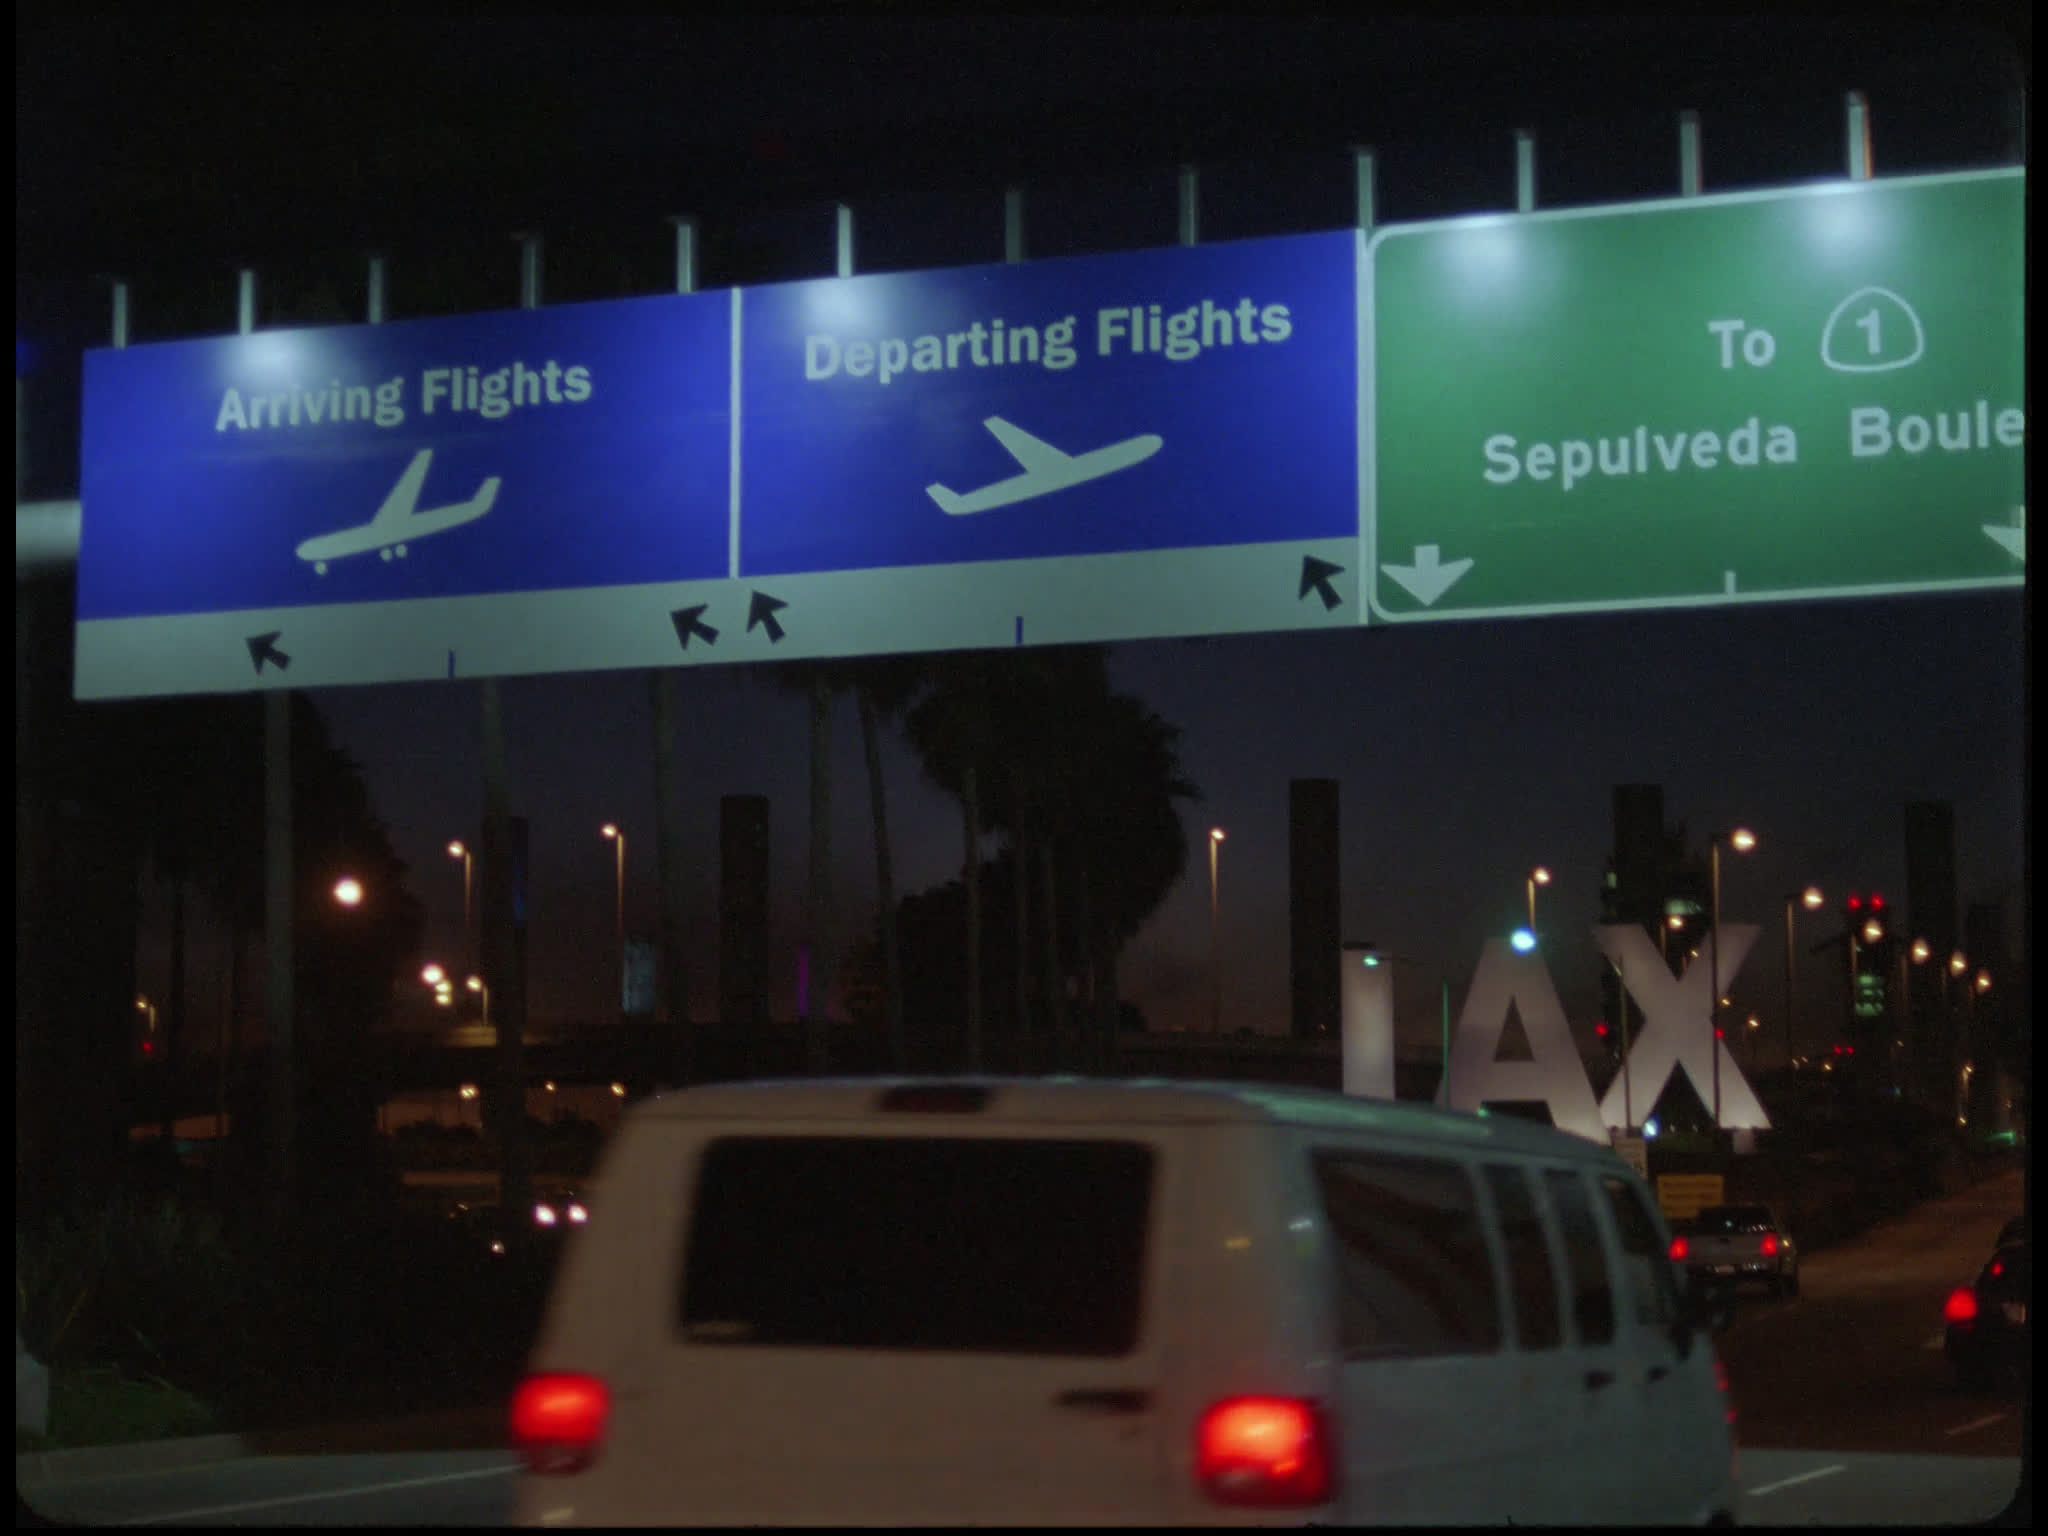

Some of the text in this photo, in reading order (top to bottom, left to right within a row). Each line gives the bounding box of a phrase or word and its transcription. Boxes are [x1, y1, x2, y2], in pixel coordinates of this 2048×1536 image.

[805, 298, 1292, 385] Departing Flights
[1708, 309, 1881, 369] To 1
[215, 360, 592, 432] Arriving Flights
[1483, 417, 1798, 491] Sepulveda
